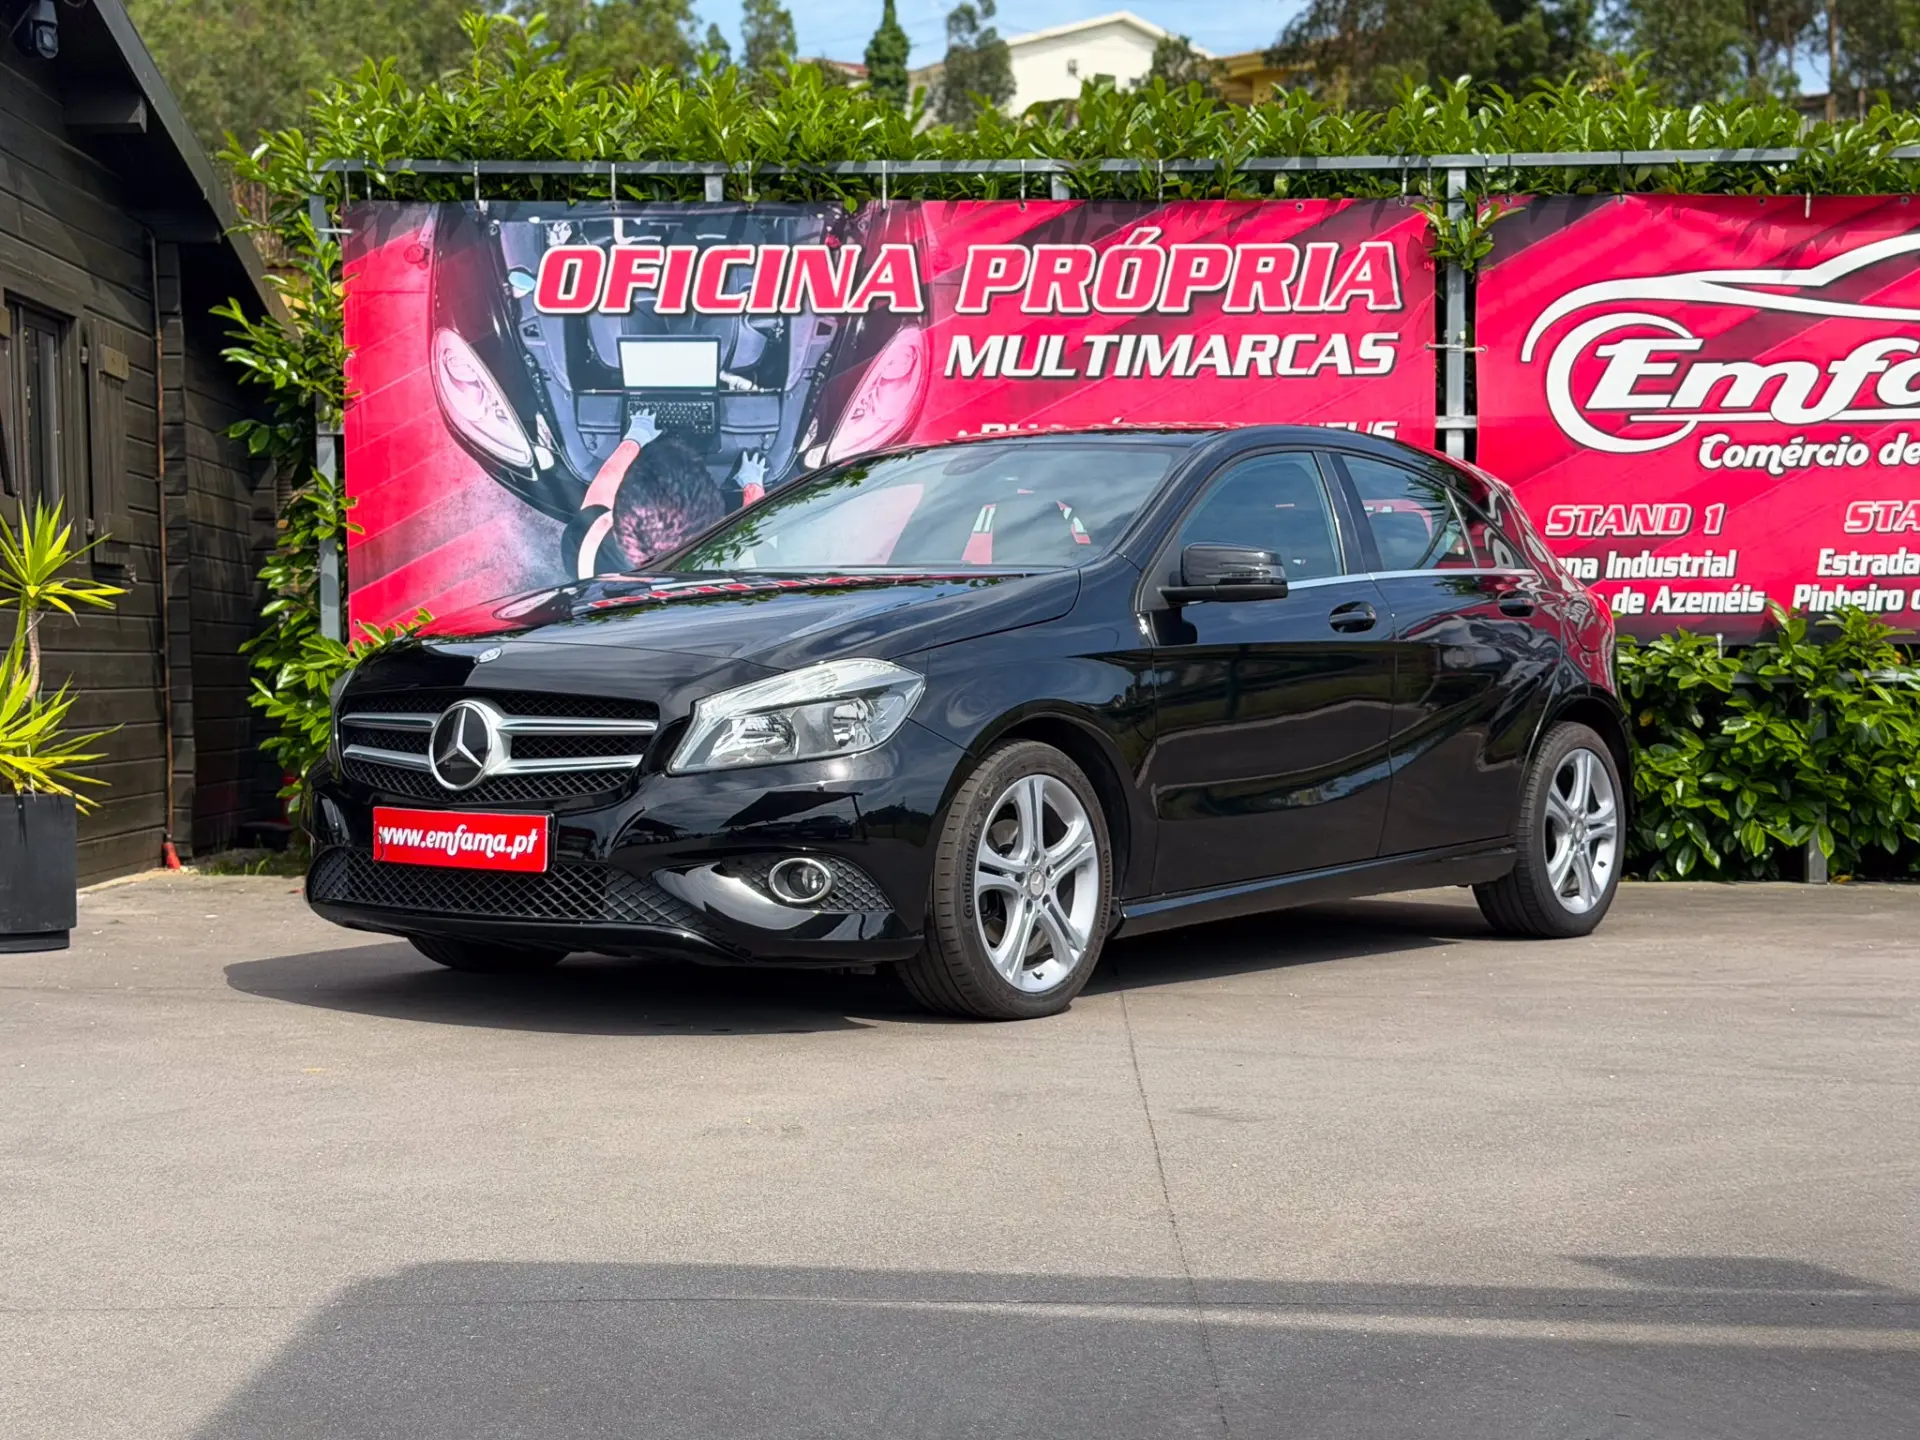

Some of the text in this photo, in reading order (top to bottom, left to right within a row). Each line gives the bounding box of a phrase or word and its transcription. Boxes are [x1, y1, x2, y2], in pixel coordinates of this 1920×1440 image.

[534, 227, 1402, 314] OFICINA PRÓPRIA
[944, 332, 1399, 377] MULTIMARCAS
[1700, 433, 1920, 475] Comércio de
[1545, 503, 1725, 536] STAND 1
[1844, 499, 1920, 533] STA
[1605, 550, 1738, 579] Industrial
[1816, 546, 1920, 576] Estrada
[1611, 583, 1765, 614] de Azeméis
[1792, 583, 1905, 612] Pinheiro
[378, 824, 538, 860] www.emfama.pt
[963, 832, 978, 919] Continental
